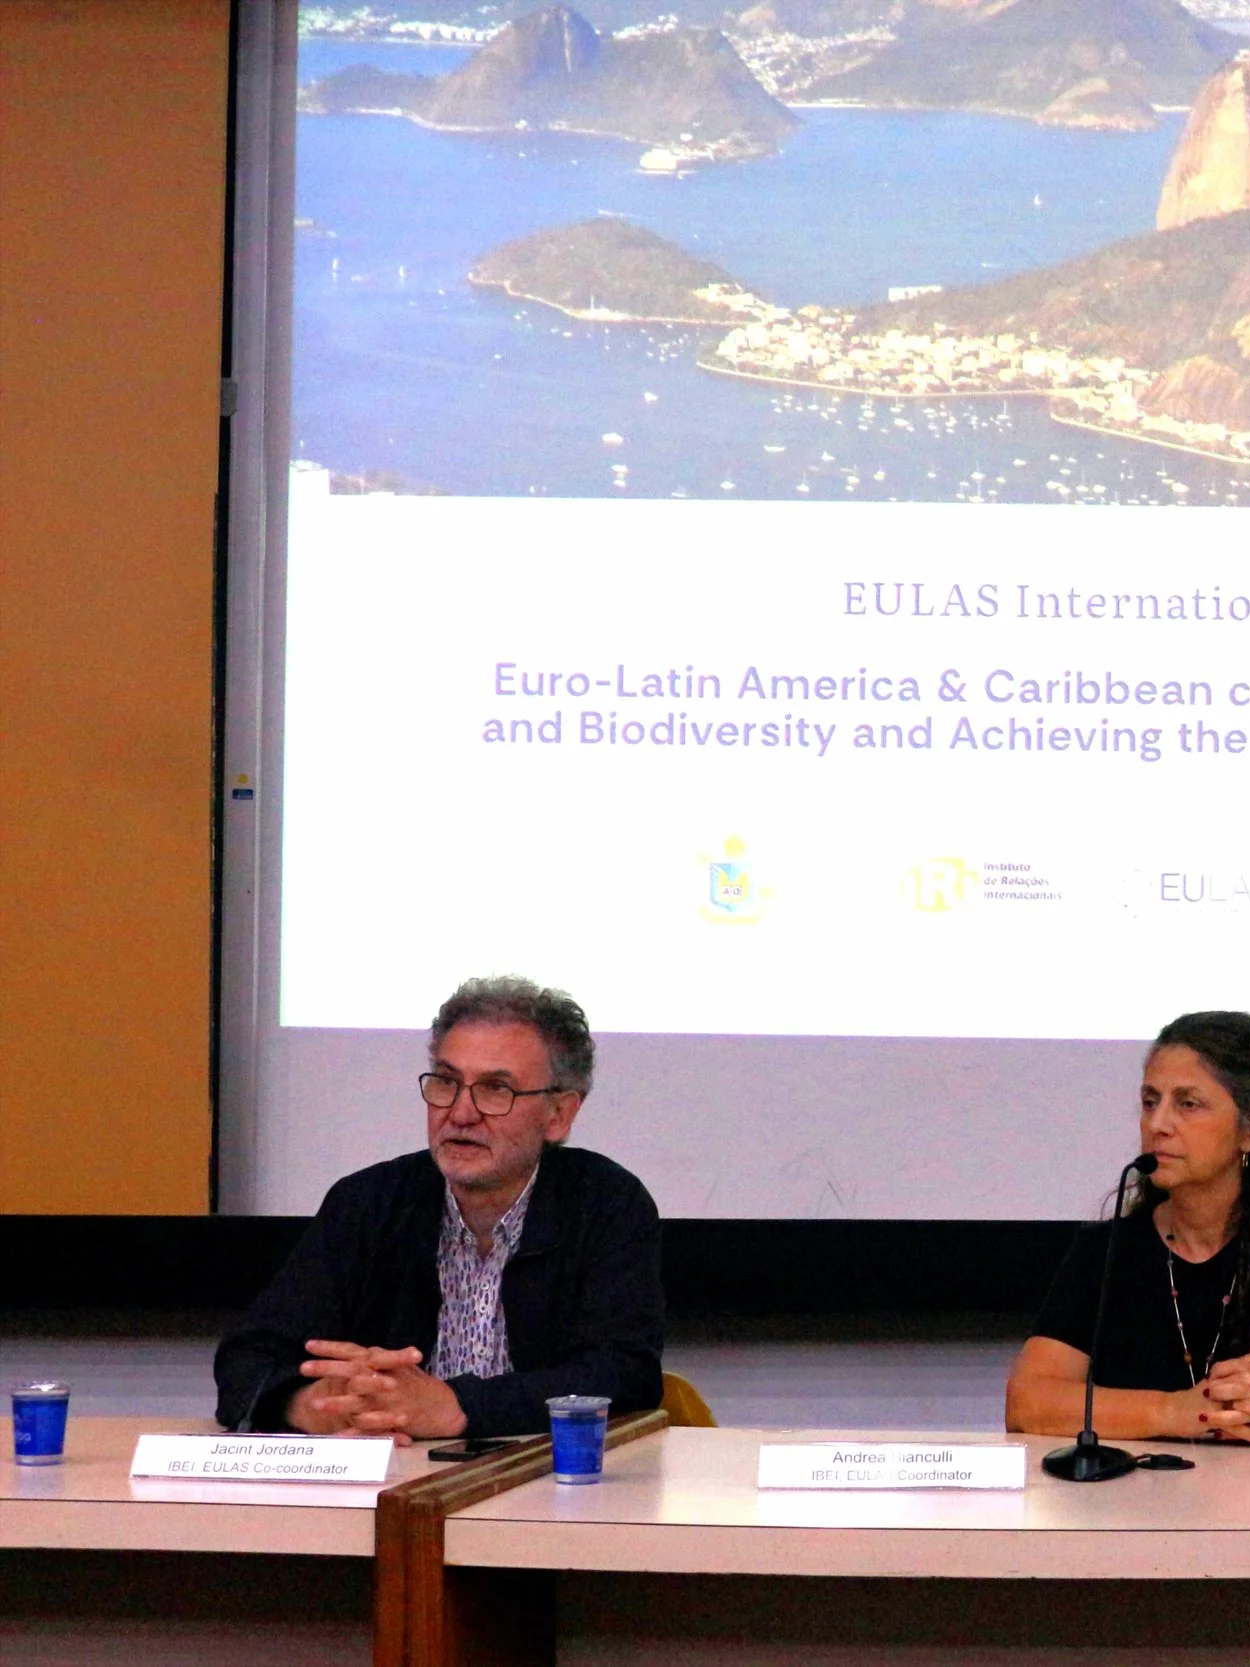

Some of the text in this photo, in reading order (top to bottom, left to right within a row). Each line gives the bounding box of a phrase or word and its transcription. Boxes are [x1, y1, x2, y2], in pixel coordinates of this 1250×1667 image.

[842, 582, 999, 618] EULAS
[494, 662, 722, 700] Euro-Latin
[737, 665, 921, 702] America
[937, 667, 968, 702] &
[984, 668, 1213, 707] Caribbean
[481, 710, 563, 745] and
[579, 711, 837, 758] Biodiversity
[851, 715, 933, 750] and
[949, 716, 1164, 764] Achieving
[1177, 720, 1248, 755] the
[210, 1443, 314, 1456] Jacint Jordana
[832, 1451, 953, 1464] Andrea ianculli
[202, 1461, 249, 1473] EULAS
[253, 1463, 348, 1475] Co-coordinator
[847, 1470, 893, 1482] EULA
[897, 1469, 973, 1482] Coordinator
